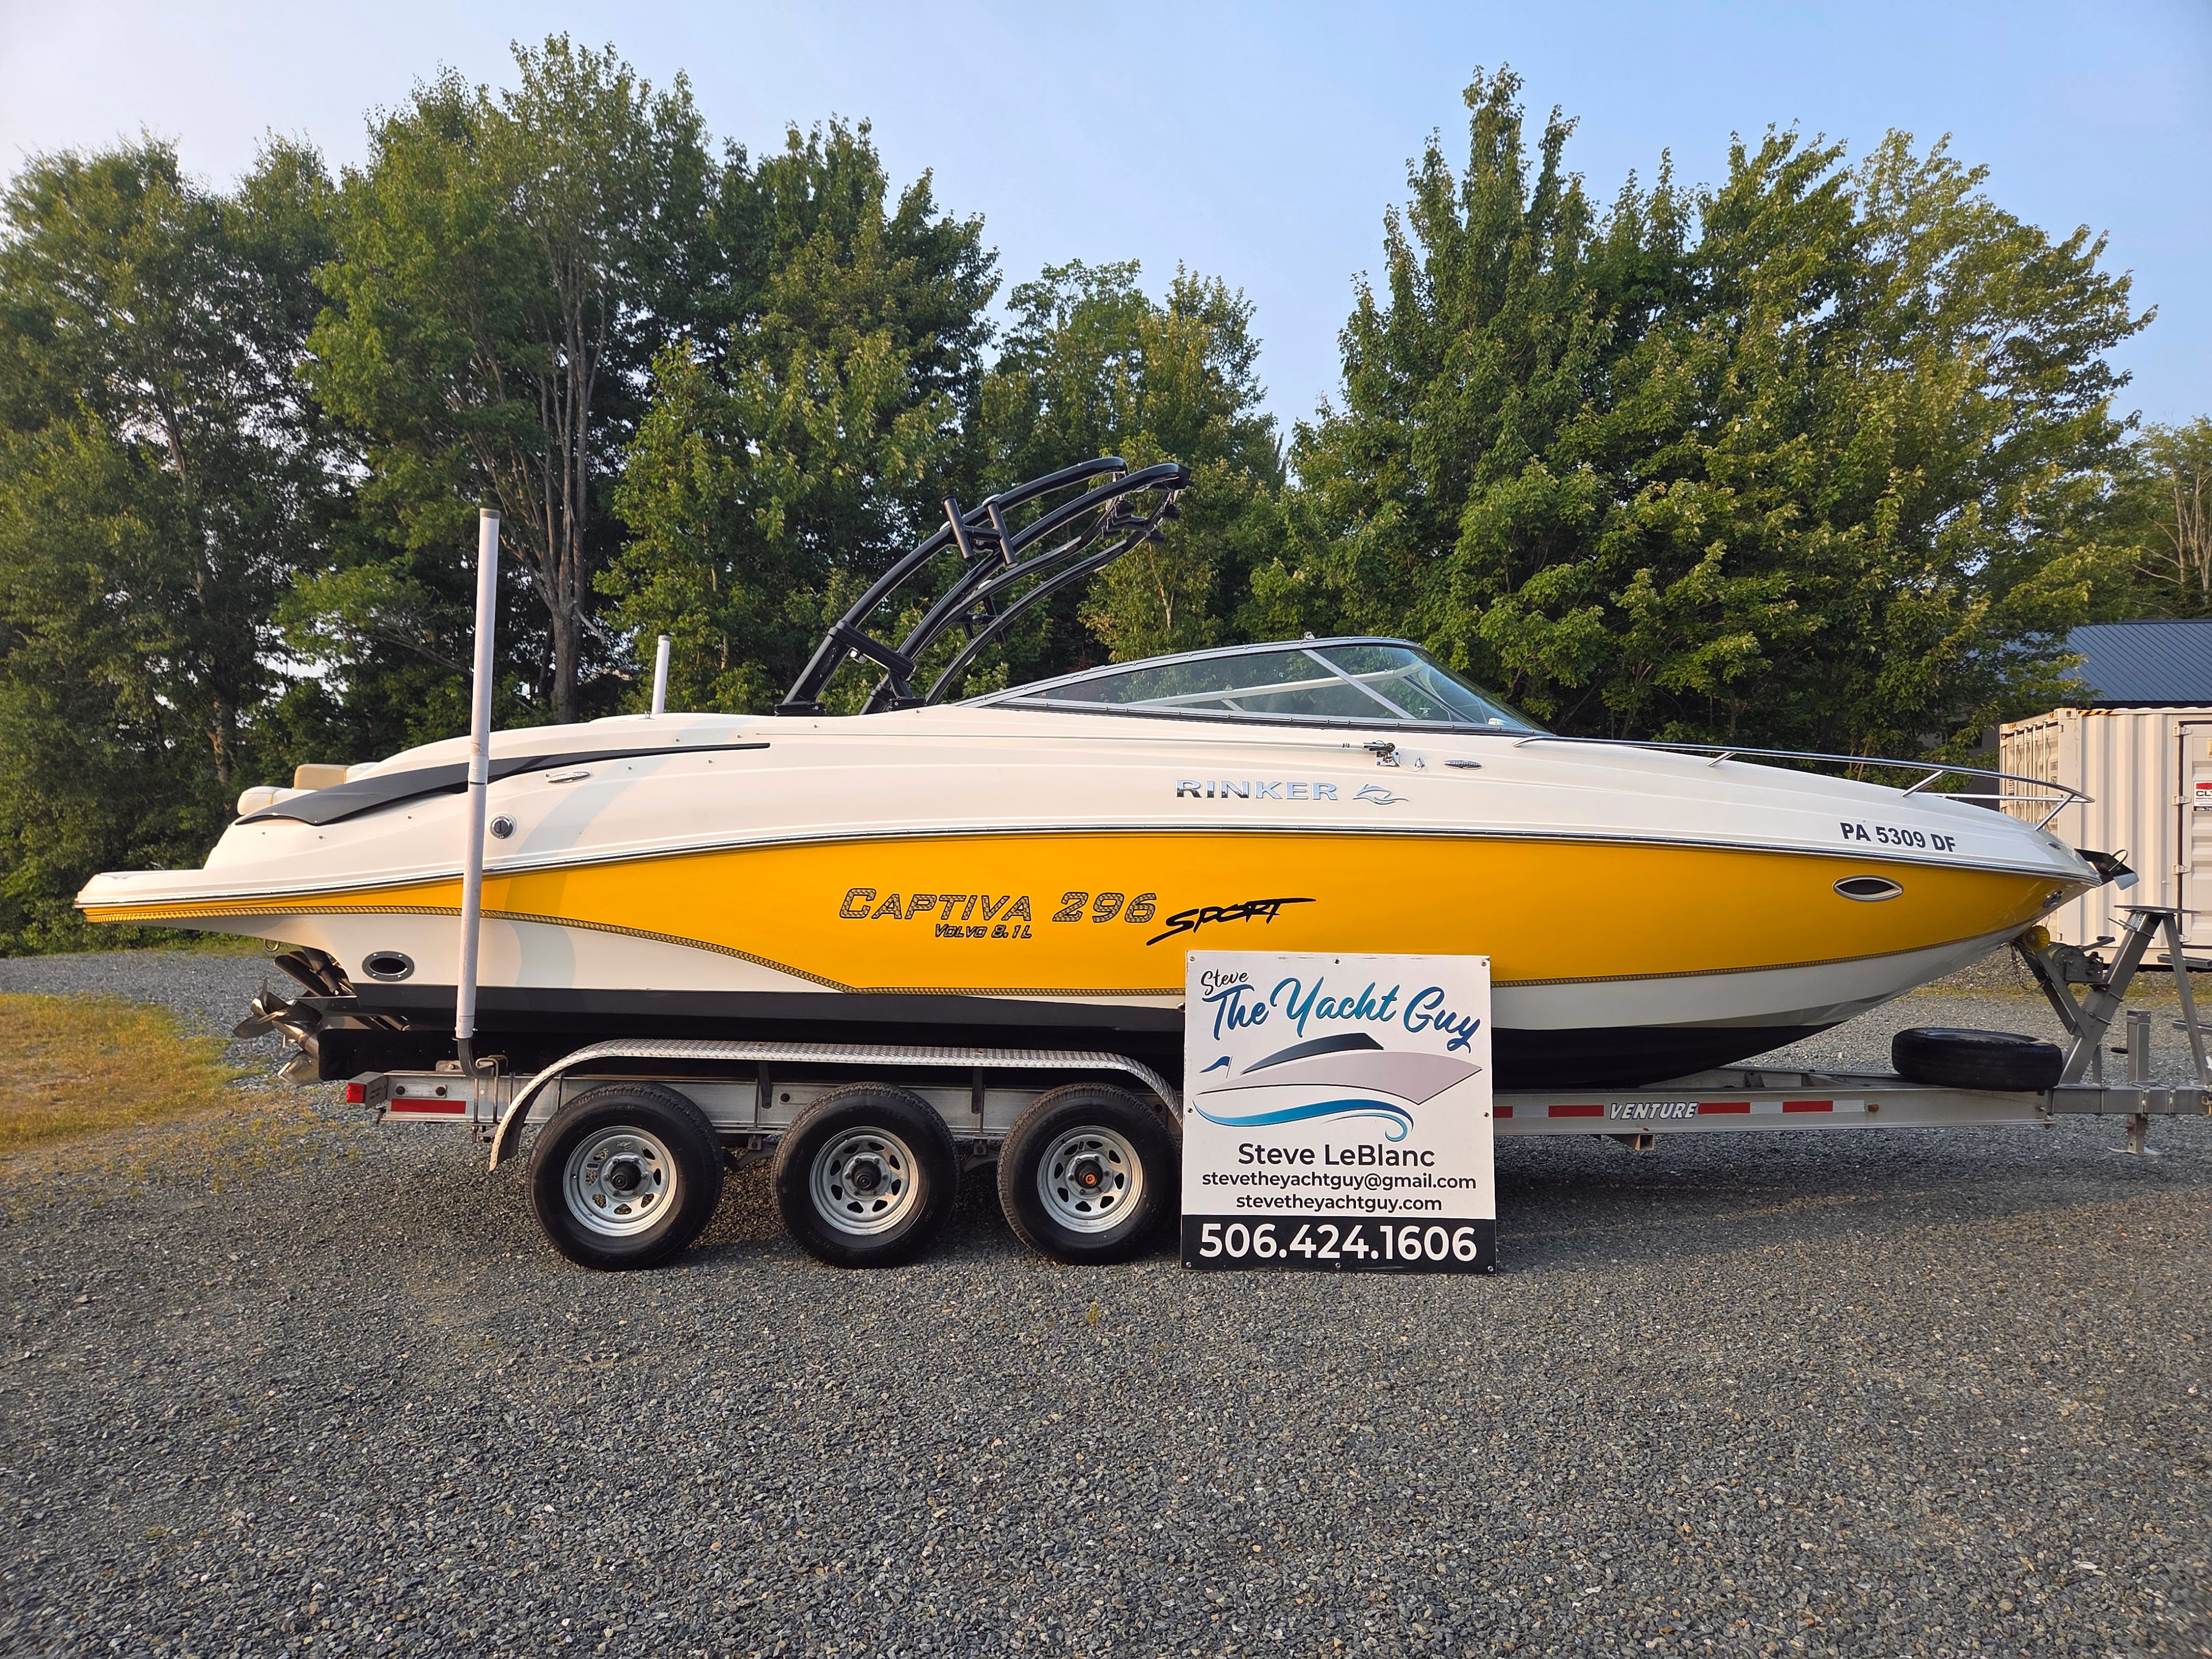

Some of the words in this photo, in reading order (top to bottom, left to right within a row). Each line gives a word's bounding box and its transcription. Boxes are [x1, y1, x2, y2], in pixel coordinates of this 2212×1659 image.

[1176, 779, 1339, 801] RINKER
[1840, 822, 1871, 842] PA
[1876, 826, 1926, 848] 5309
[1930, 834, 1956, 852] DF
[1052, 892, 1158, 923] 296
[1146, 897, 1316, 946] SPORT
[1200, 968, 1249, 995] Steve
[1202, 984, 1269, 1041] The
[1270, 976, 1400, 1037] Yacht
[1403, 986, 1480, 1054] Guy
[1609, 1102, 1699, 1120] VENTURE
[1238, 1143, 1315, 1165] Steve
[1324, 1143, 1435, 1167] LeBlanc
[1202, 1171, 1476, 1190] stevetheyachtguy@gmail.com
[1236, 1194, 1442, 1213] stevetheyachtguy.com
[1199, 1223, 1477, 1262] 506.424.1606
